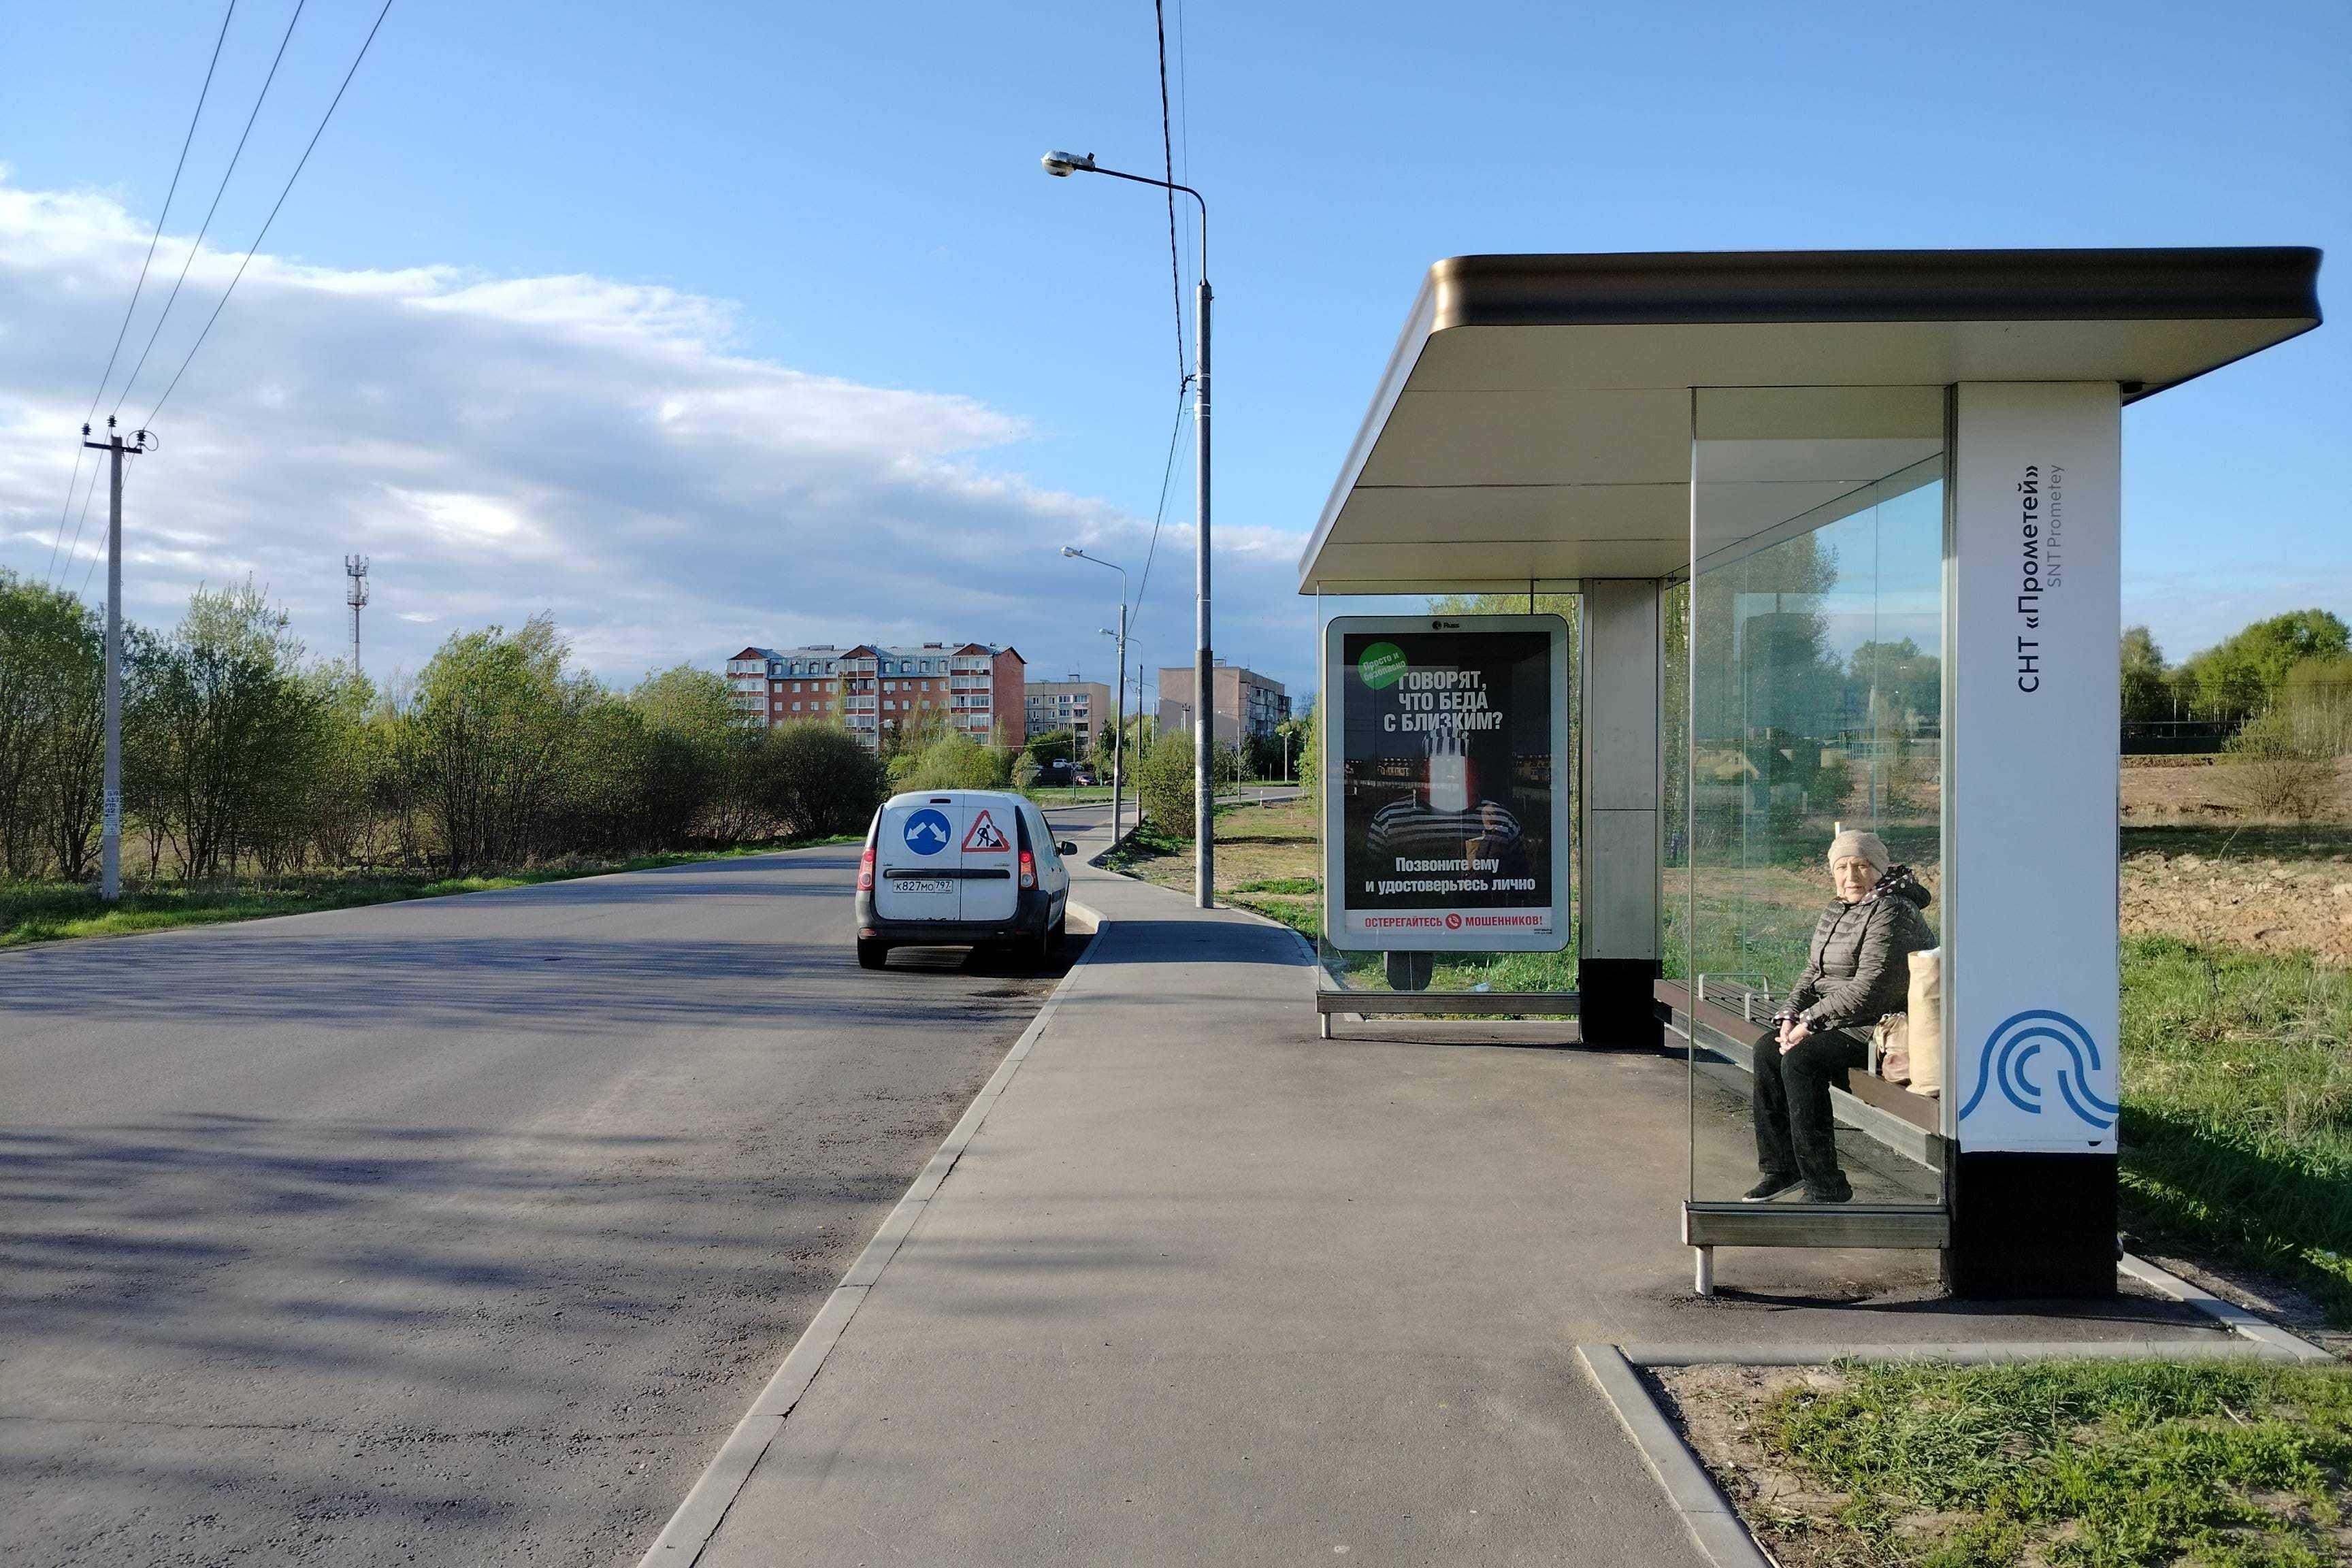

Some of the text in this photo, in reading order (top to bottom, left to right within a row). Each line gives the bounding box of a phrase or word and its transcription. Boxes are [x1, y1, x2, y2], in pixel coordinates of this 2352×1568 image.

[2046, 464, 2065, 588] SNT Prometey
[2017, 465, 2043, 693] СНТ «Прометей»
[1362, 655, 1392, 671] Просто
[1363, 660, 1406, 681] безопасно
[1399, 670, 1486, 691] ГОВОРЯТ,
[1399, 691, 1488, 713] ЧТО БЕДА
[1384, 711, 1503, 732] С БЛИЗКИМ?
[1395, 857, 1499, 873] Позвоните ему
[1365, 878, 1535, 896] и удостоверьтесь лично
[1365, 915, 1543, 928] ОСТЕРЕГАЙТЕСЬ МОШЕННИКОВ!
